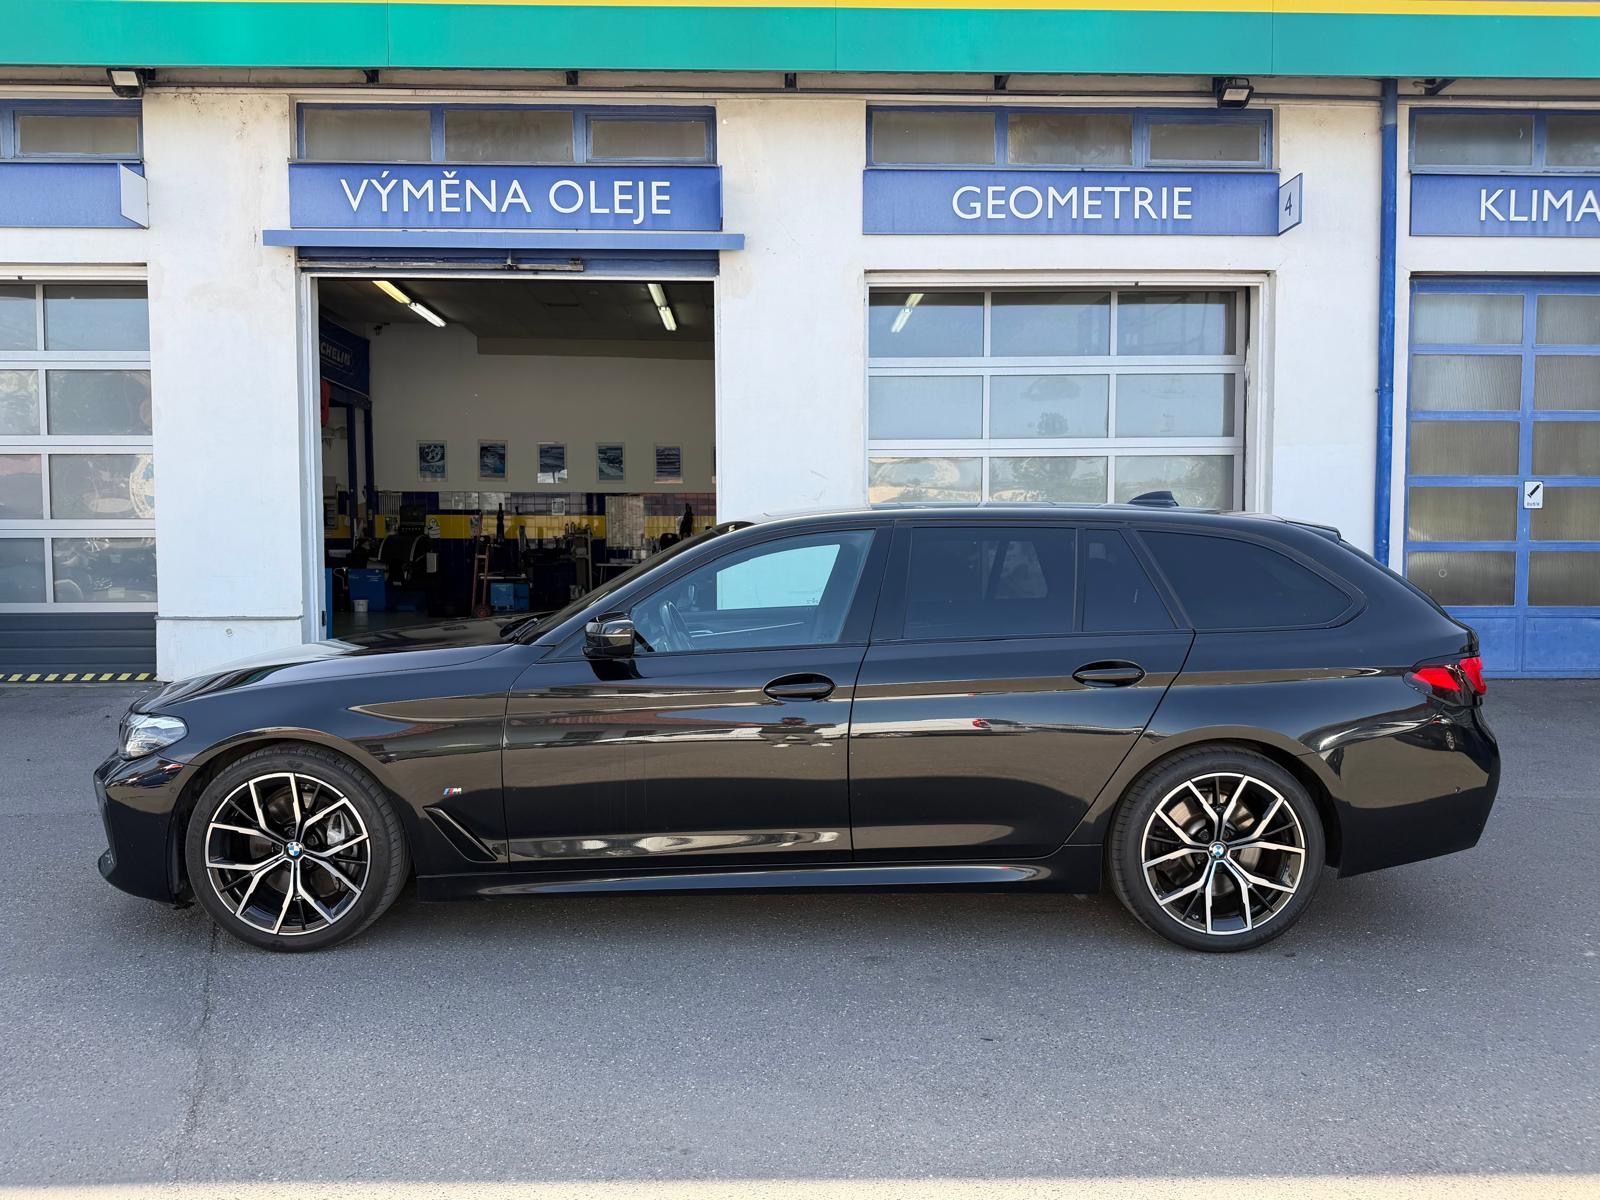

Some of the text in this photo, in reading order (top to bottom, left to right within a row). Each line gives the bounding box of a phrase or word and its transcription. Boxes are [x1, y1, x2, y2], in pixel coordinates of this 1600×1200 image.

[341, 171, 670, 224] VÝMĚNA OLEJE
[953, 186, 1191, 219] GEOMETRIE
[1285, 192, 1292, 216] 4
[1481, 190, 1600, 221] KLIMA
